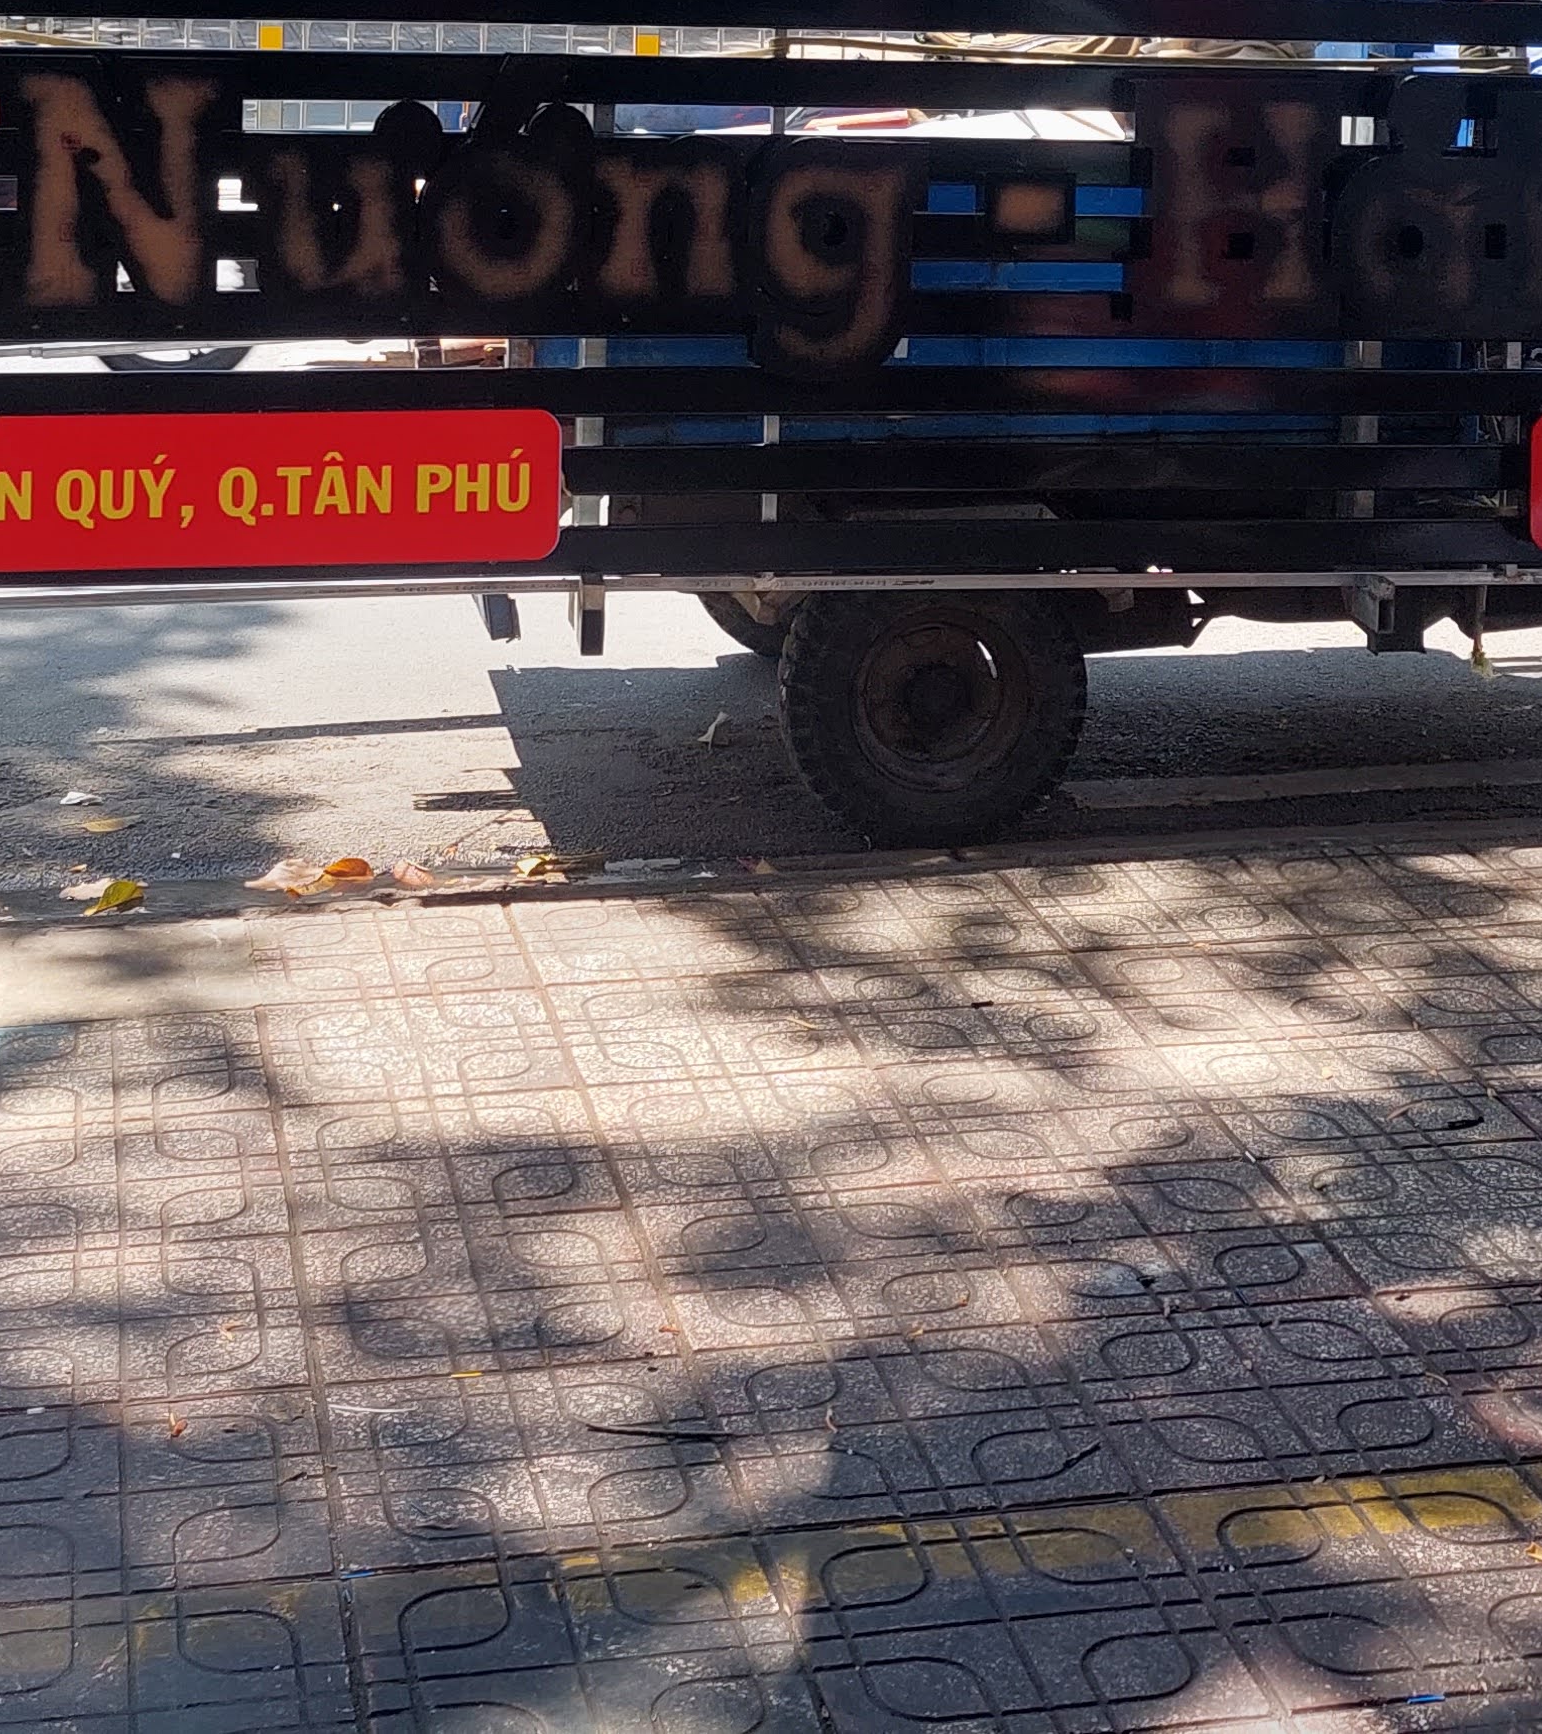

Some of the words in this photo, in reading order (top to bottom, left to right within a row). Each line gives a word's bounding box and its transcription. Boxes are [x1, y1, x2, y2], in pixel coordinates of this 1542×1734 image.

[56, 454, 196, 528] QUÝ,
[218, 451, 394, 523] Q.TÂN
[416, 448, 532, 513] PHÚ
